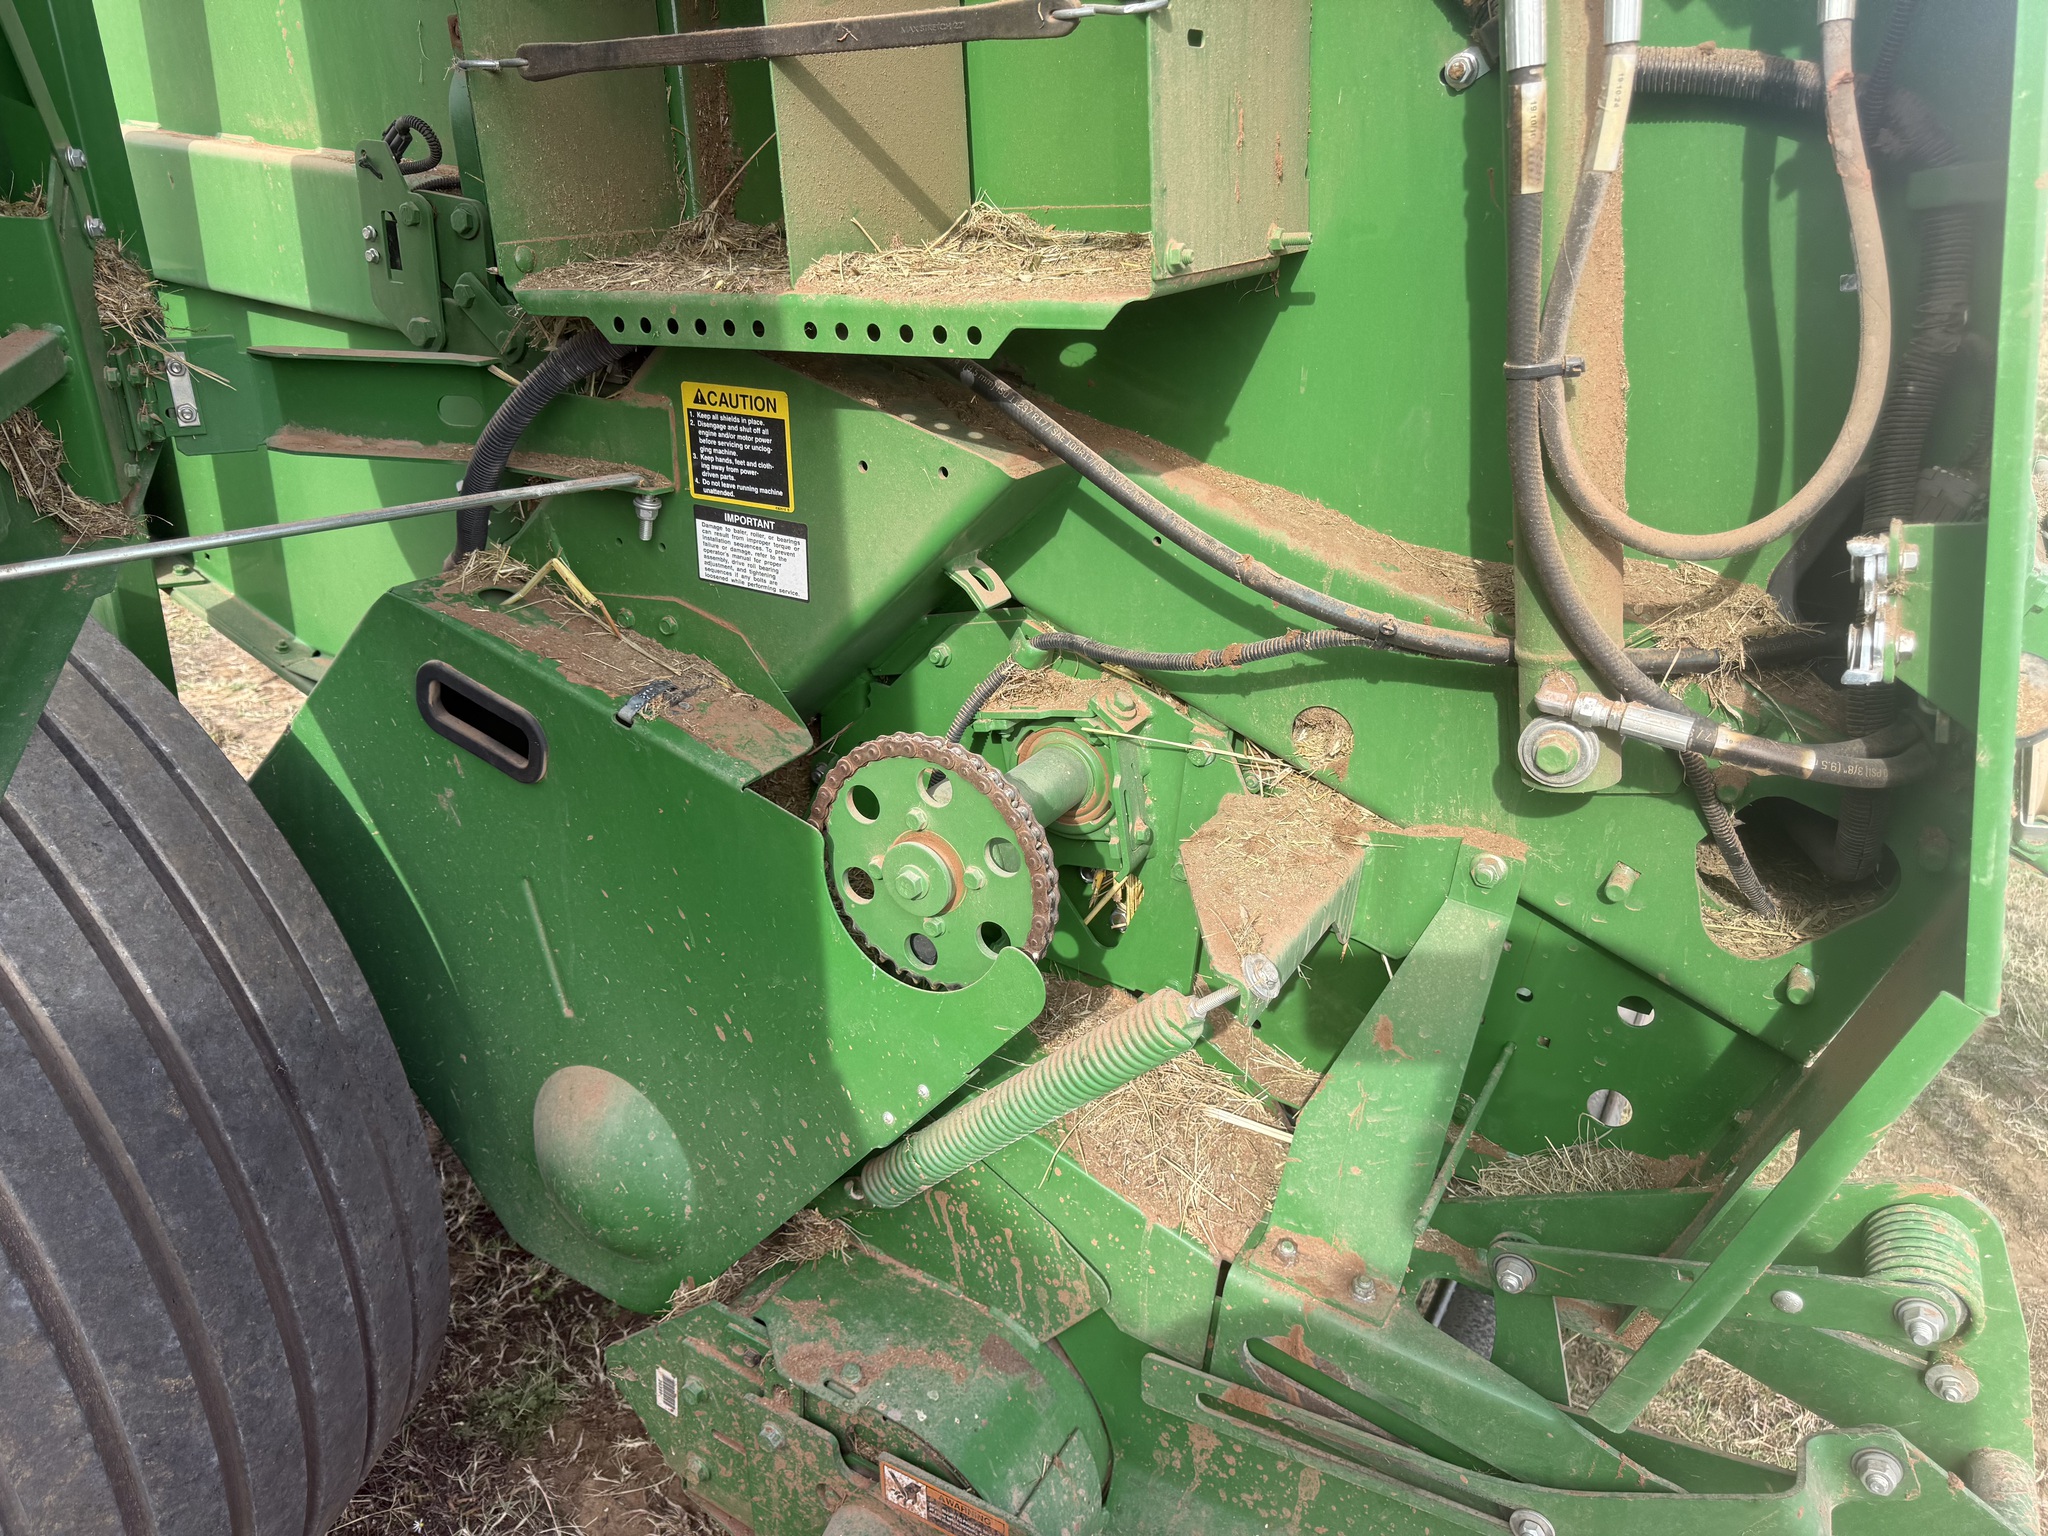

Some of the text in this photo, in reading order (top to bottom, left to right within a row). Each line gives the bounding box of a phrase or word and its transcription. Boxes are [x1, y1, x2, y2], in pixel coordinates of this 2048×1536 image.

[707, 390, 777, 413] CAUTION
[697, 412, 711, 420] Keep
[720, 415, 740, 423] shields
[741, 416, 747, 424] in
[748, 418, 765, 426] place.
[698, 420, 726, 431] Disengage
[740, 425, 752, 433] shut
[699, 437, 716, 445] before
[718, 440, 743, 450] servicing
[751, 445, 772, 454] unclog-
[718, 432, 736, 440] and/or
[737, 434, 754, 442] motor
[700, 446, 738, 457] ging machine.
[700, 454, 714, 463] Keep
[715, 456, 734, 465] hands,
[735, 458, 745, 466] feet
[758, 462, 774, 470] cloth-
[701, 462, 710, 470] ing
[711, 465, 725, 473] away
[726, 465, 739, 473] from
[702, 471, 736, 482] driven parts.
[996, 385, 1010, 399] ISO
[1050, 428, 1066, 442] SAE
[1195, 533, 1230, 559] Resistant
[703, 488, 735, 498] unattended.
[721, 481, 736, 490] leave
[737, 484, 758, 494] running
[759, 488, 784, 496] machine
[724, 512, 775, 530] IMPORTANT
[702, 522, 723, 531] Damage
[733, 528, 748, 536] baler,
[750, 532, 766, 540] roller,
[776, 536, 800, 545] bearings
[702, 534, 731, 545] installation
[734, 541, 763, 551] sequences.
[703, 541, 719, 549] failure
[730, 546, 752, 556] damage,
[747, 537, 770, 546] improper
[773, 542, 791, 551] torque
[703, 548, 729, 557] operator's
[732, 553, 751, 562] manual
[764, 560, 782, 568] proper
[704, 554, 729, 565] assembly,
[732, 559, 745, 567] drive
[759, 565, 779, 574] bearing
[704, 560, 734, 572] adjustment,
[749, 569, 776, 580] tightening
[704, 566, 732, 577] sequences
[741, 574, 750, 582] any
[753, 576, 766, 584] bolts
[704, 572, 800, 597] loosened while performing service.
[945, 1498, 991, 1525] WARNING
